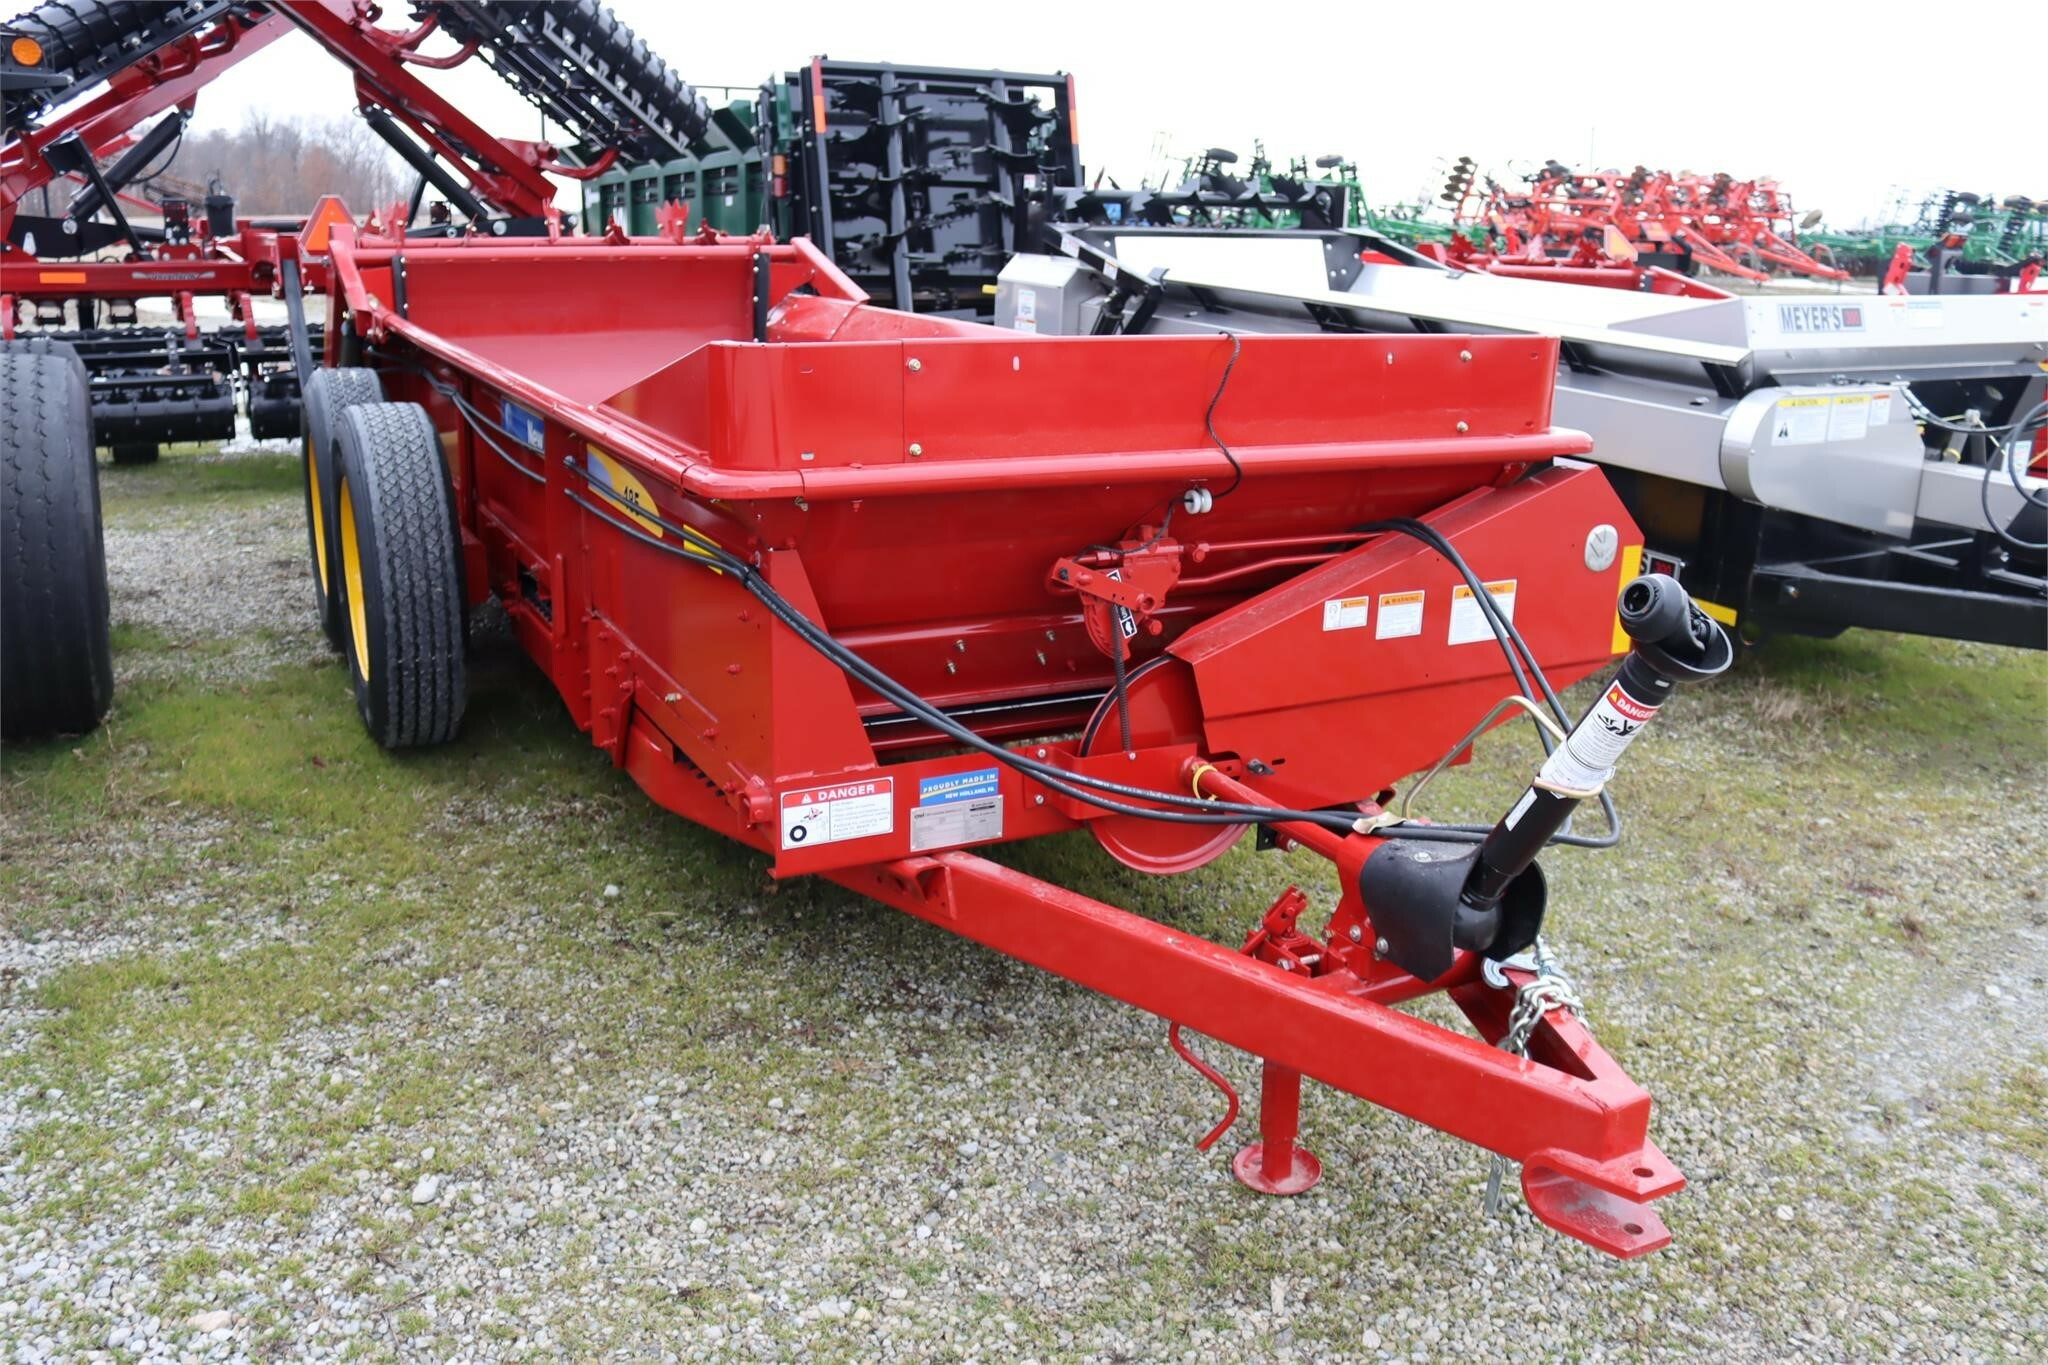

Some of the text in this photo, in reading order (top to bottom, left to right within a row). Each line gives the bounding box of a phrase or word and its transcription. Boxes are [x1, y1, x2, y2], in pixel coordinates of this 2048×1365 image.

[1780, 306, 1842, 331] MEYER'S
[818, 784, 875, 801] DANGER
[923, 780, 960, 793] PROUDLY
[962, 775, 984, 785] MADE
